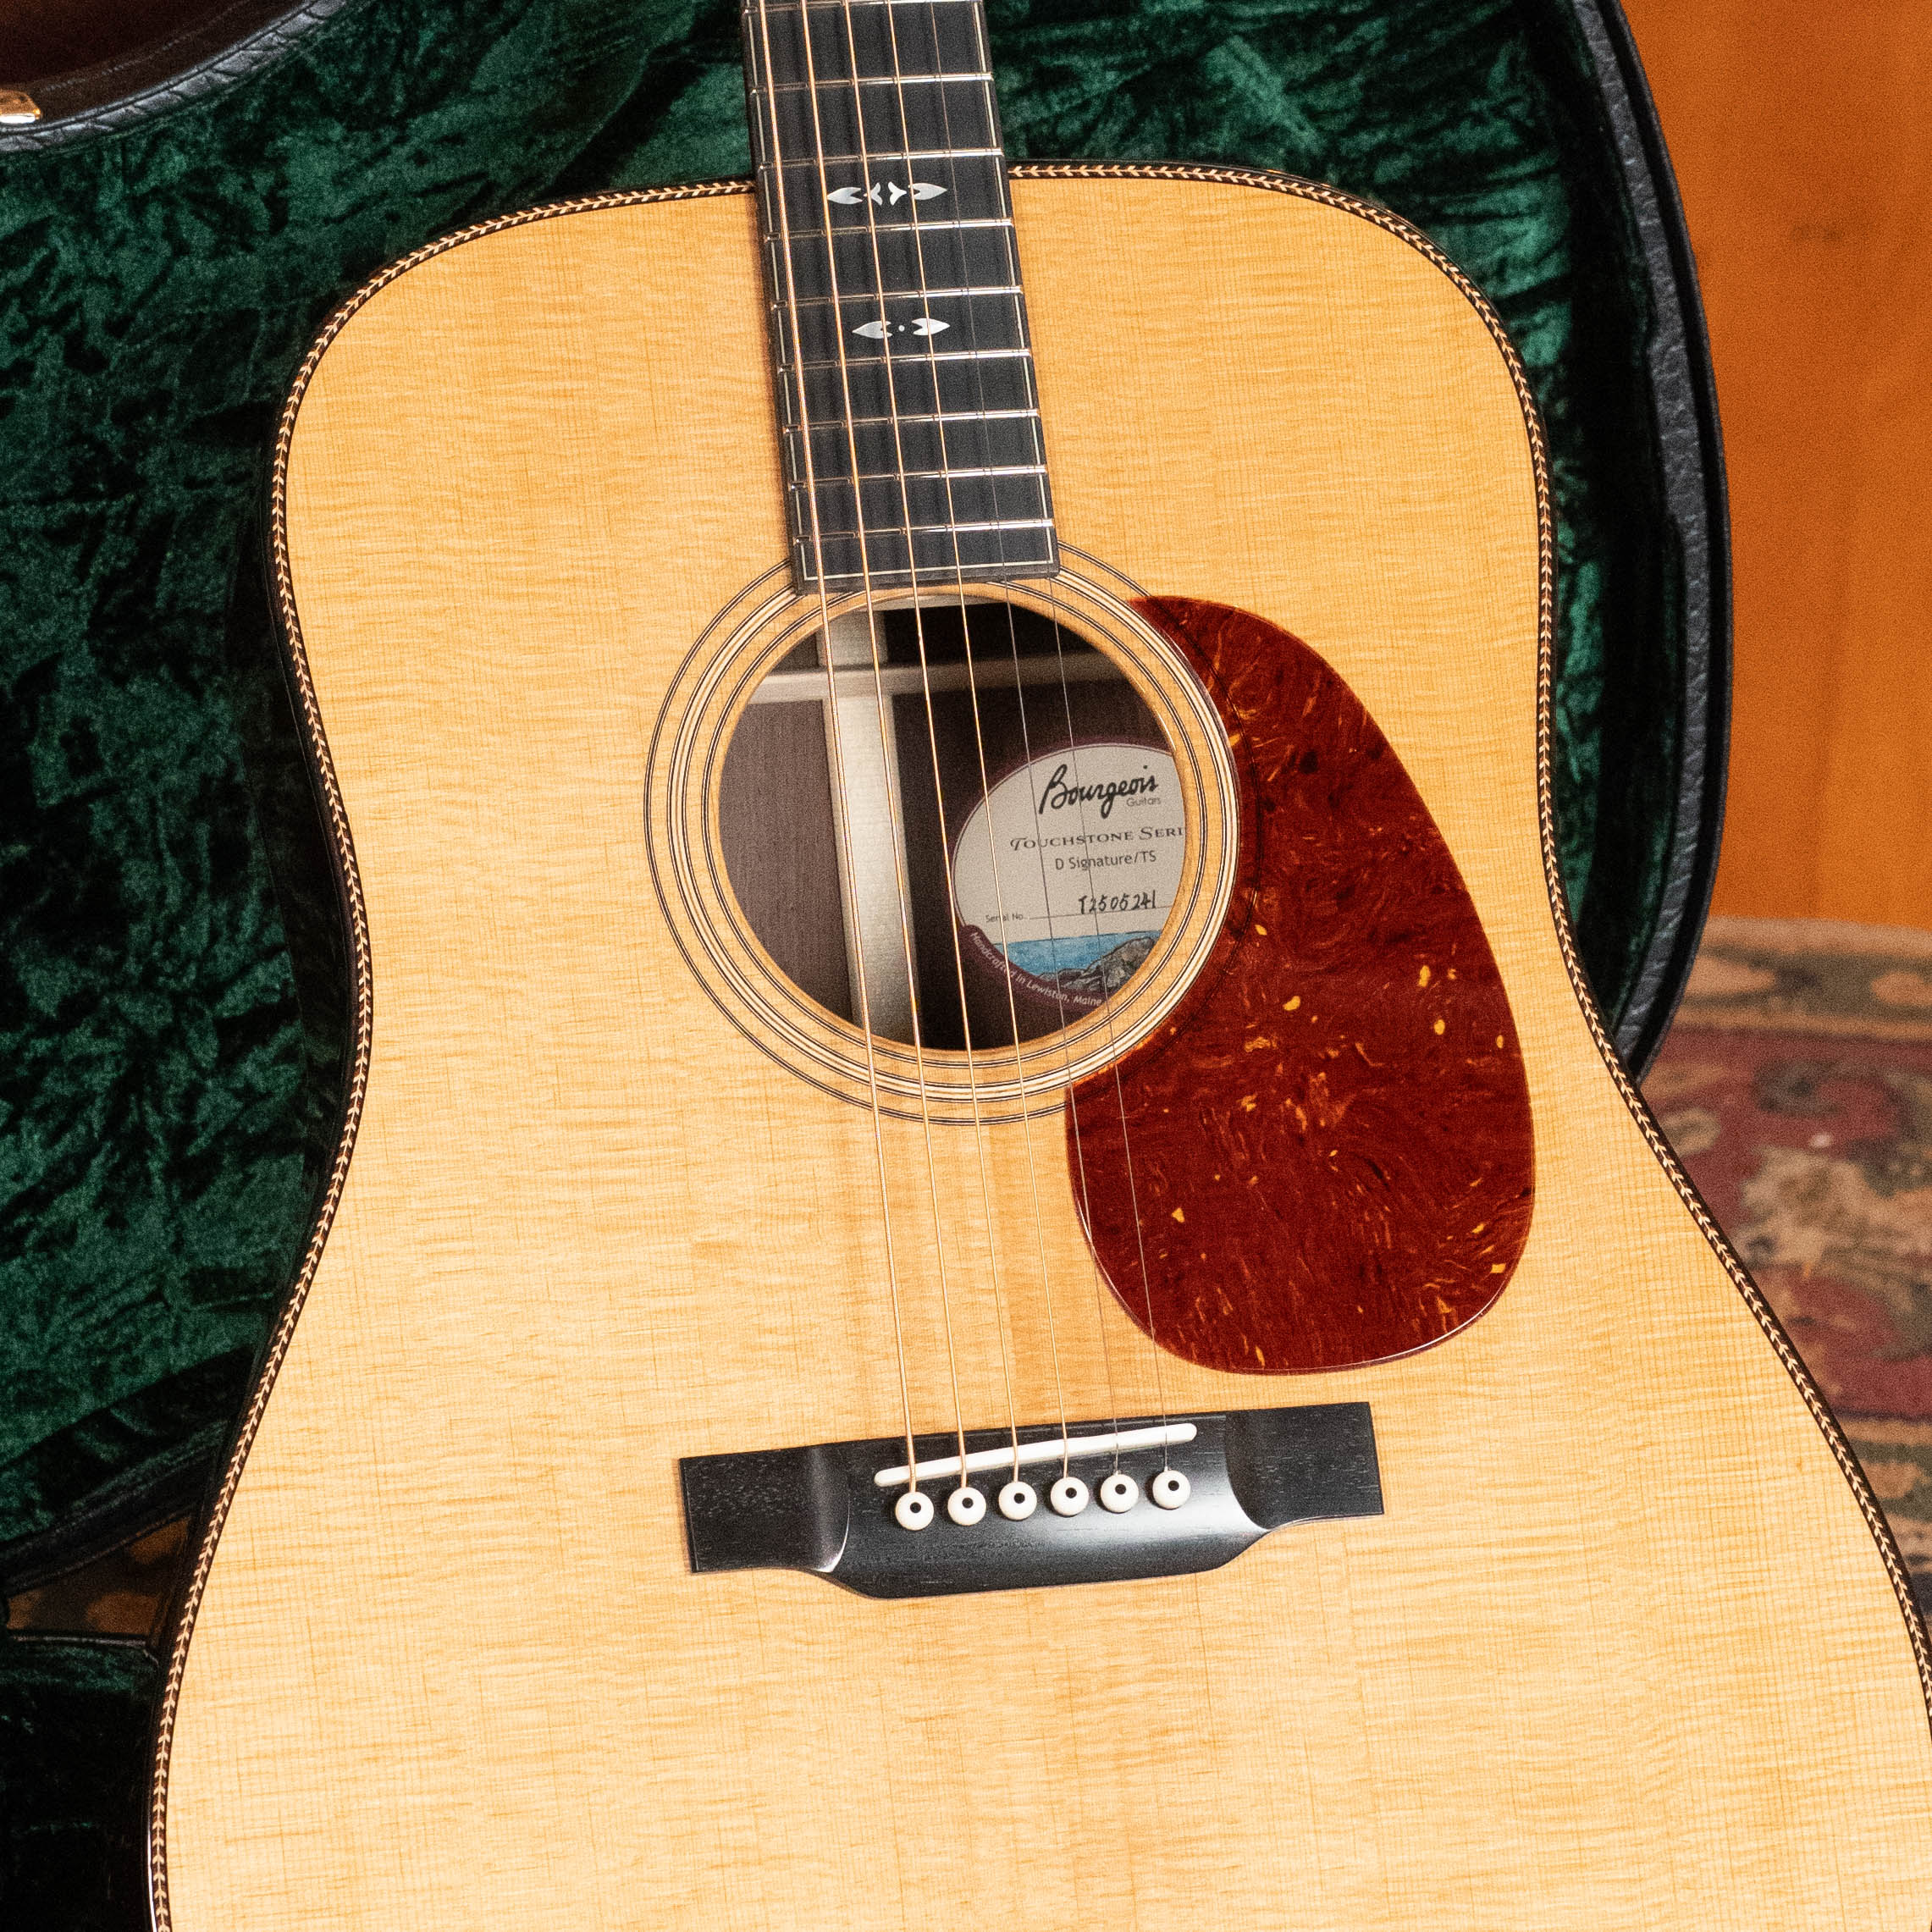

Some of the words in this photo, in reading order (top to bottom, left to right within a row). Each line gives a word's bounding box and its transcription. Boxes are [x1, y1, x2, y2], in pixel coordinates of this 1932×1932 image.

[1038, 764, 1159, 820] Bourgeois
[1125, 796, 1162, 808] Guitars
[1055, 858, 1064, 870] D
[1068, 849, 1157, 871] Signature/TS
[1078, 889, 1156, 915] T2505241
[985, 912, 1010, 924] Seral
